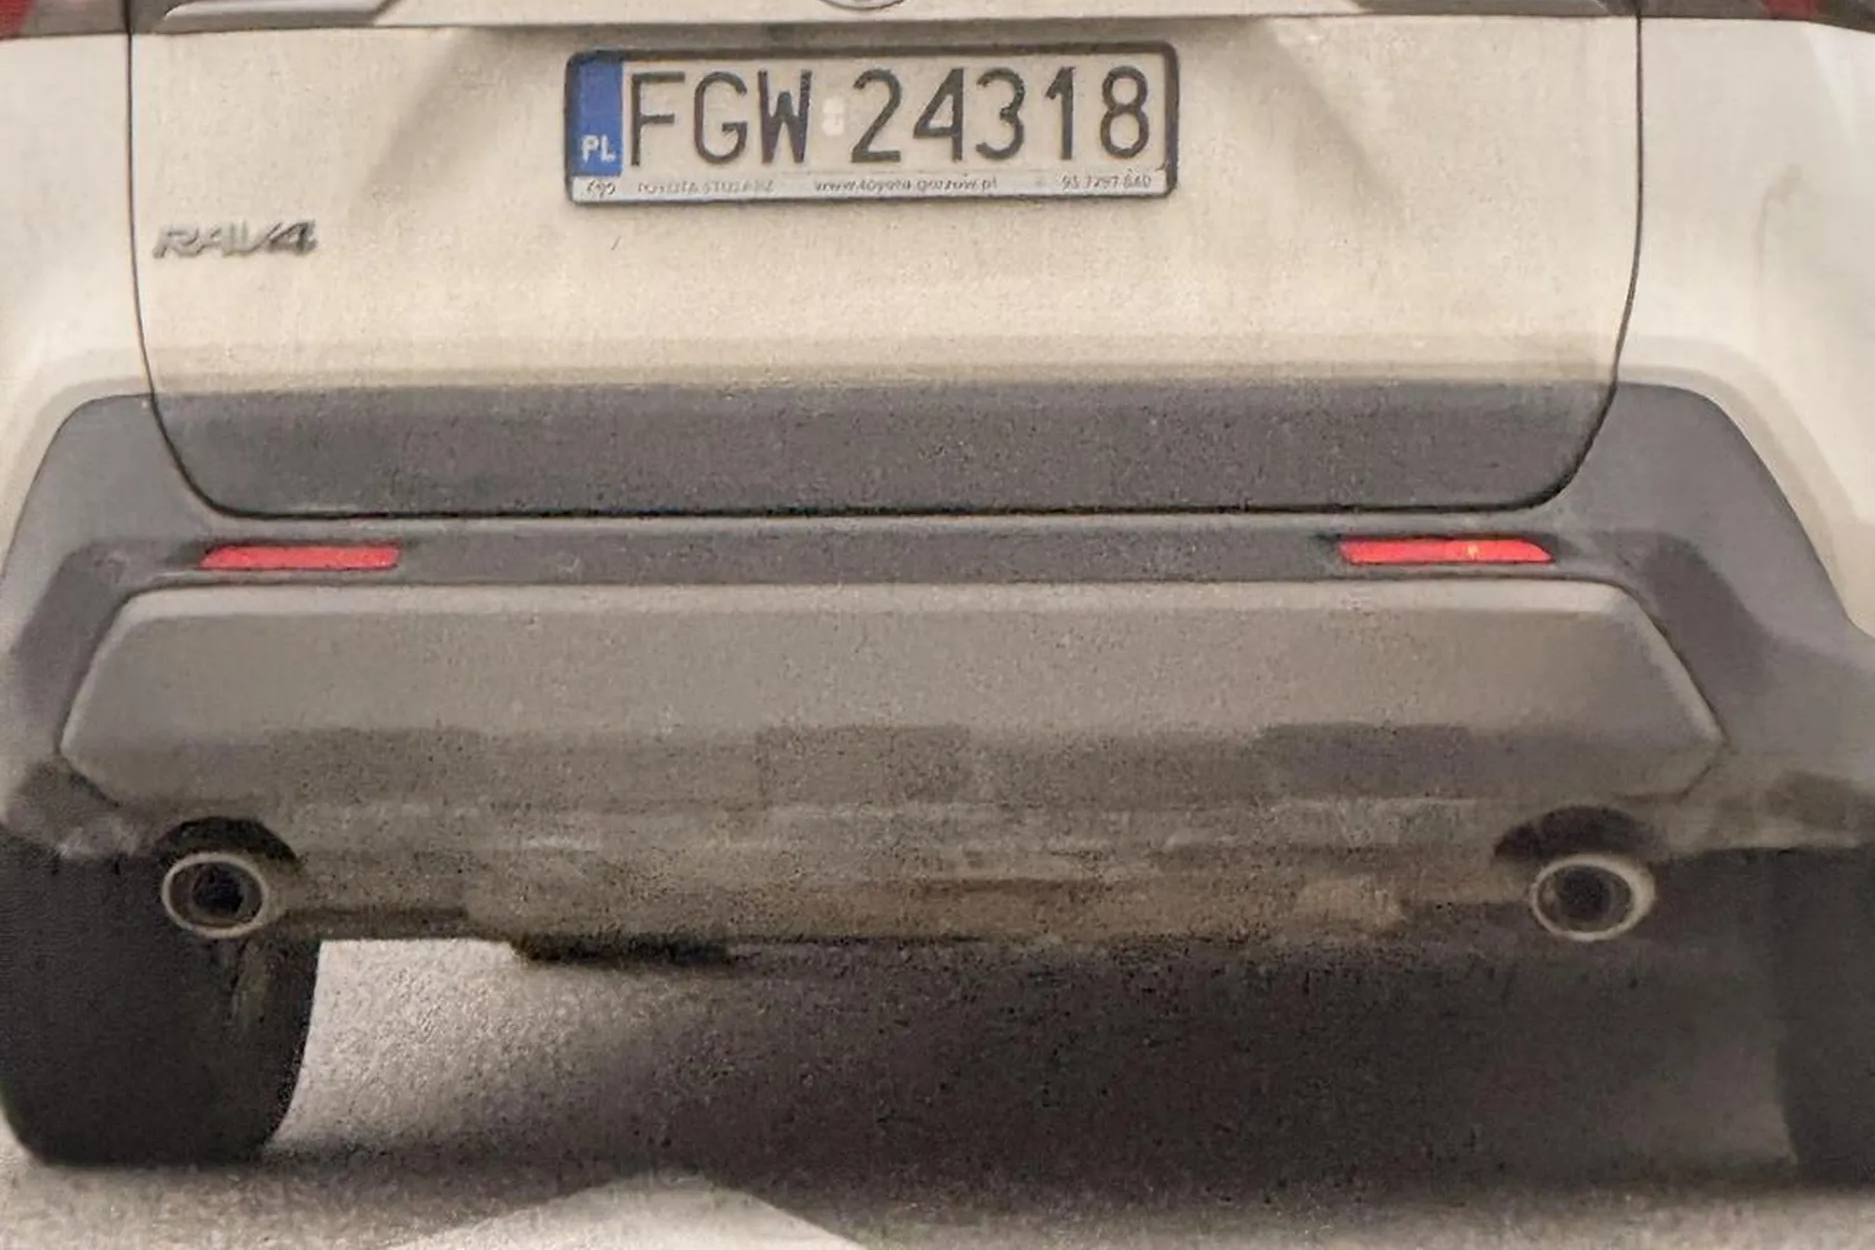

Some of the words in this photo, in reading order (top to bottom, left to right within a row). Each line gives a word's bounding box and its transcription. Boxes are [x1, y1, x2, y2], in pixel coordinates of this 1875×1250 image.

[630, 69, 813, 167] FGW
[850, 65, 1150, 164] 24318
[581, 134, 617, 163] PL
[152, 219, 318, 259] RAV4
